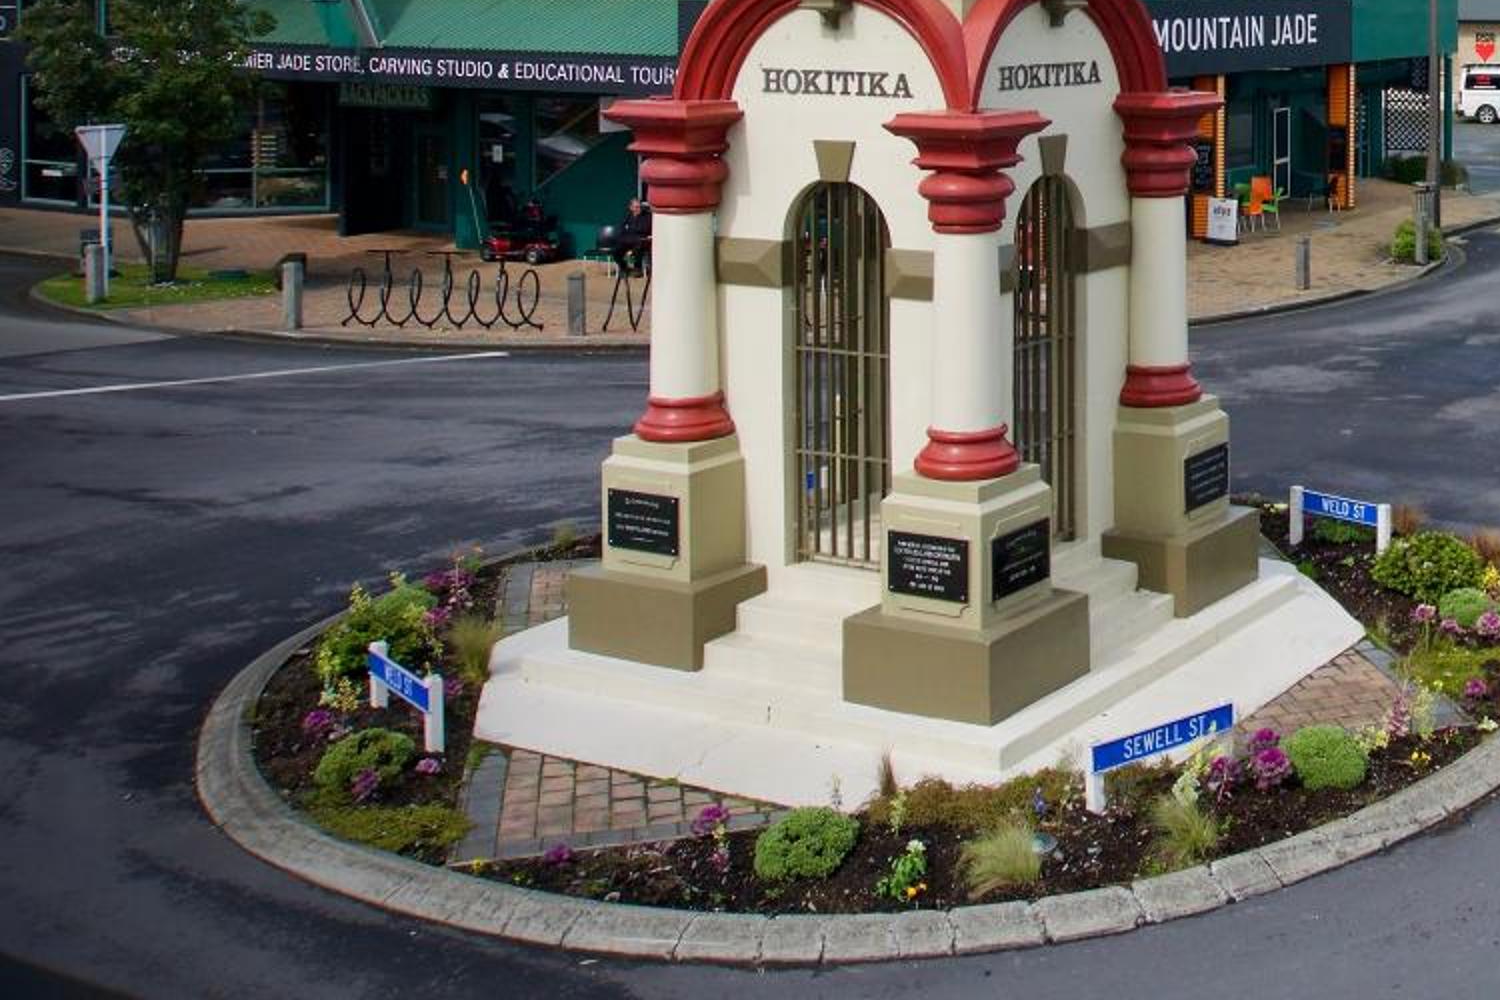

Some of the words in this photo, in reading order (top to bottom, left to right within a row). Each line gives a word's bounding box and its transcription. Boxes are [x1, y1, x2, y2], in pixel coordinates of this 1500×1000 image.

[1153, 15, 1265, 52] MOUNTAIN
[1271, 13, 1318, 46] JADE
[276, 54, 311, 71] JADE
[315, 55, 365, 74] STORE,
[369, 57, 433, 76] CARVING
[437, 59, 493, 79] STUDIO
[497, 62, 509, 79] &
[514, 62, 625, 84] EDUCATIONAL
[761, 67, 914, 99] HOKITIKA
[998, 60, 1102, 92] HOKITIKA
[1353, 502, 1365, 519] ST
[1123, 723, 1184, 760] SEWELL
[1188, 714, 1209, 738] ST
